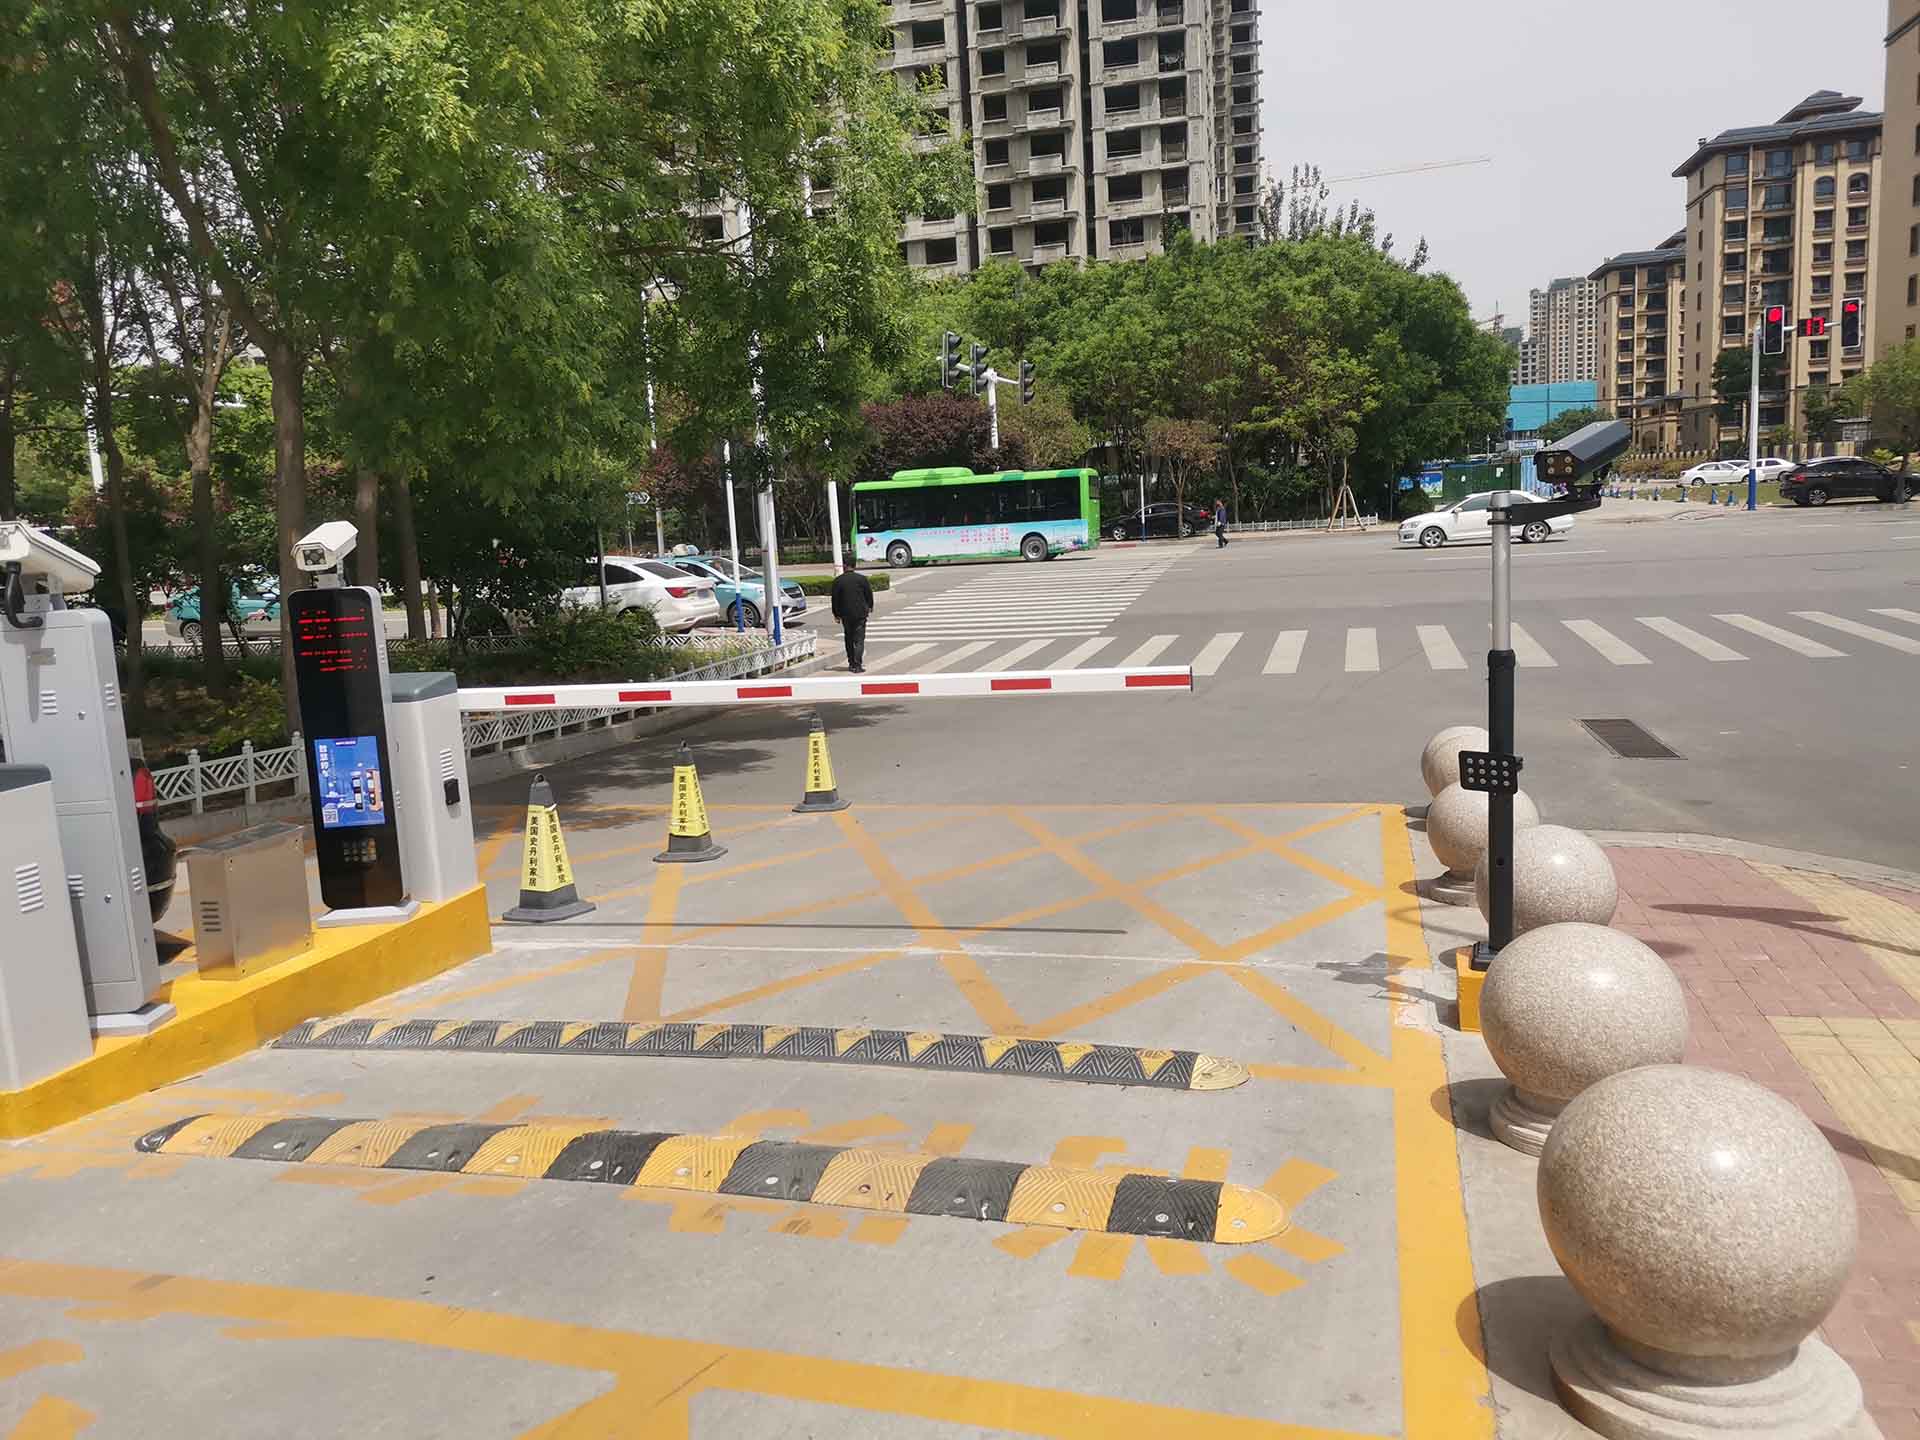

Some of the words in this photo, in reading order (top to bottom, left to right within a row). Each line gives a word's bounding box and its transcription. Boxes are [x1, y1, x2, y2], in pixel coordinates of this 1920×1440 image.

[1807, 317, 1825, 336] 17
[528, 816, 539, 887] 美国史丹利家居
[546, 813, 567, 884] 美国史丹利家居
